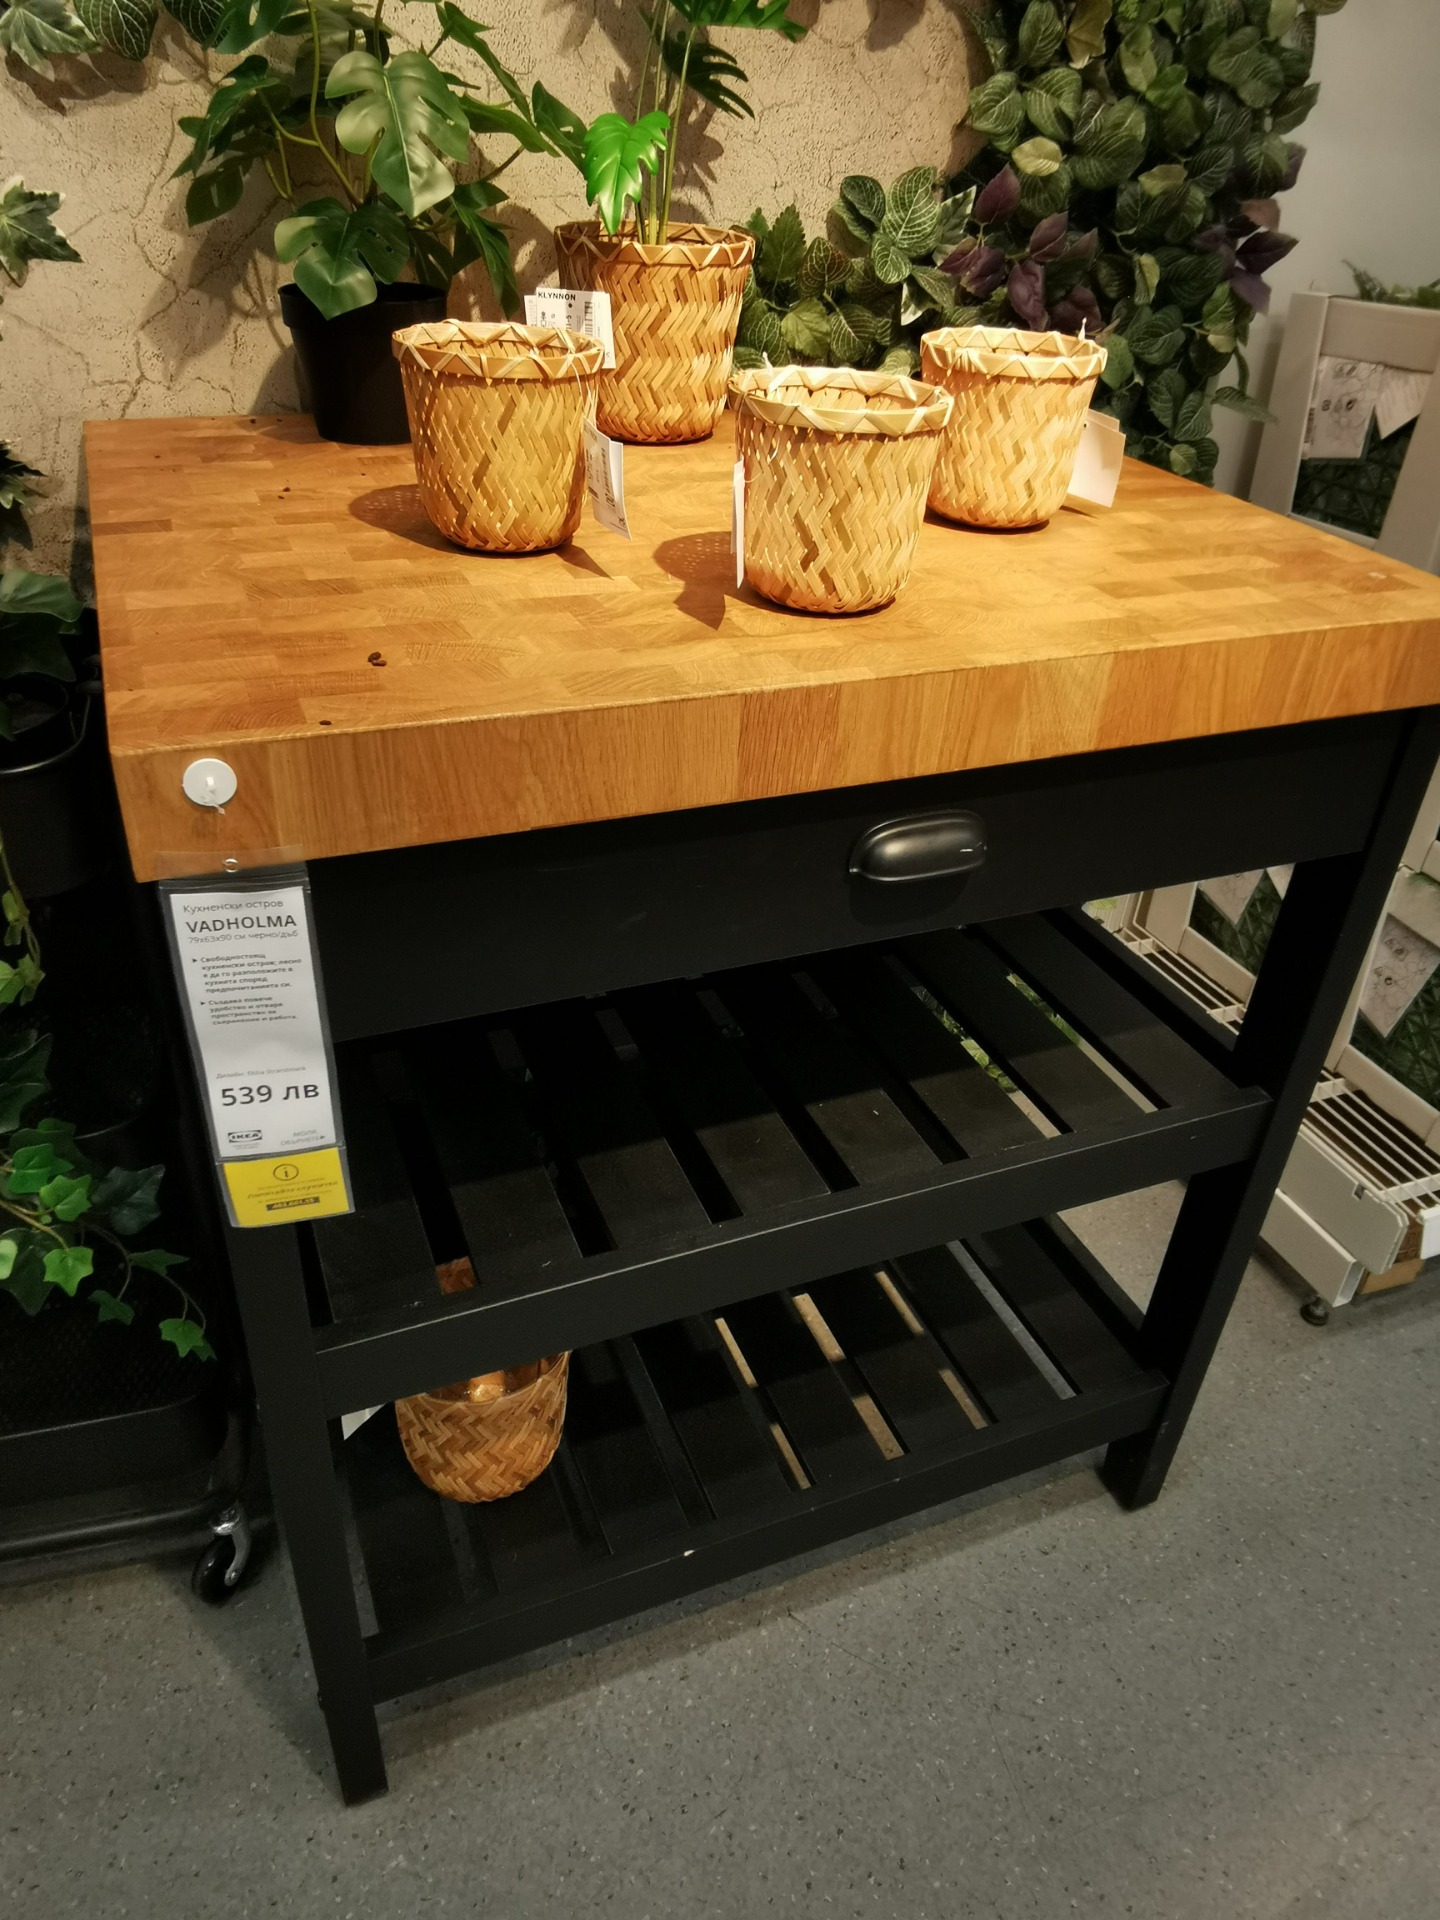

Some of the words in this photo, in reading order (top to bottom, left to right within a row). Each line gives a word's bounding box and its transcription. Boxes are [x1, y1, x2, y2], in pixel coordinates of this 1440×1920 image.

[537, 291, 576, 301] KLYNNON
[183, 903, 243, 915] Кухненски
[245, 900, 284, 910] остров
[185, 914, 297, 933] VADHOLMA
[221, 1084, 273, 1107] 539
[282, 1084, 319, 1101] лв
[230, 1131, 261, 1141] IKEA
